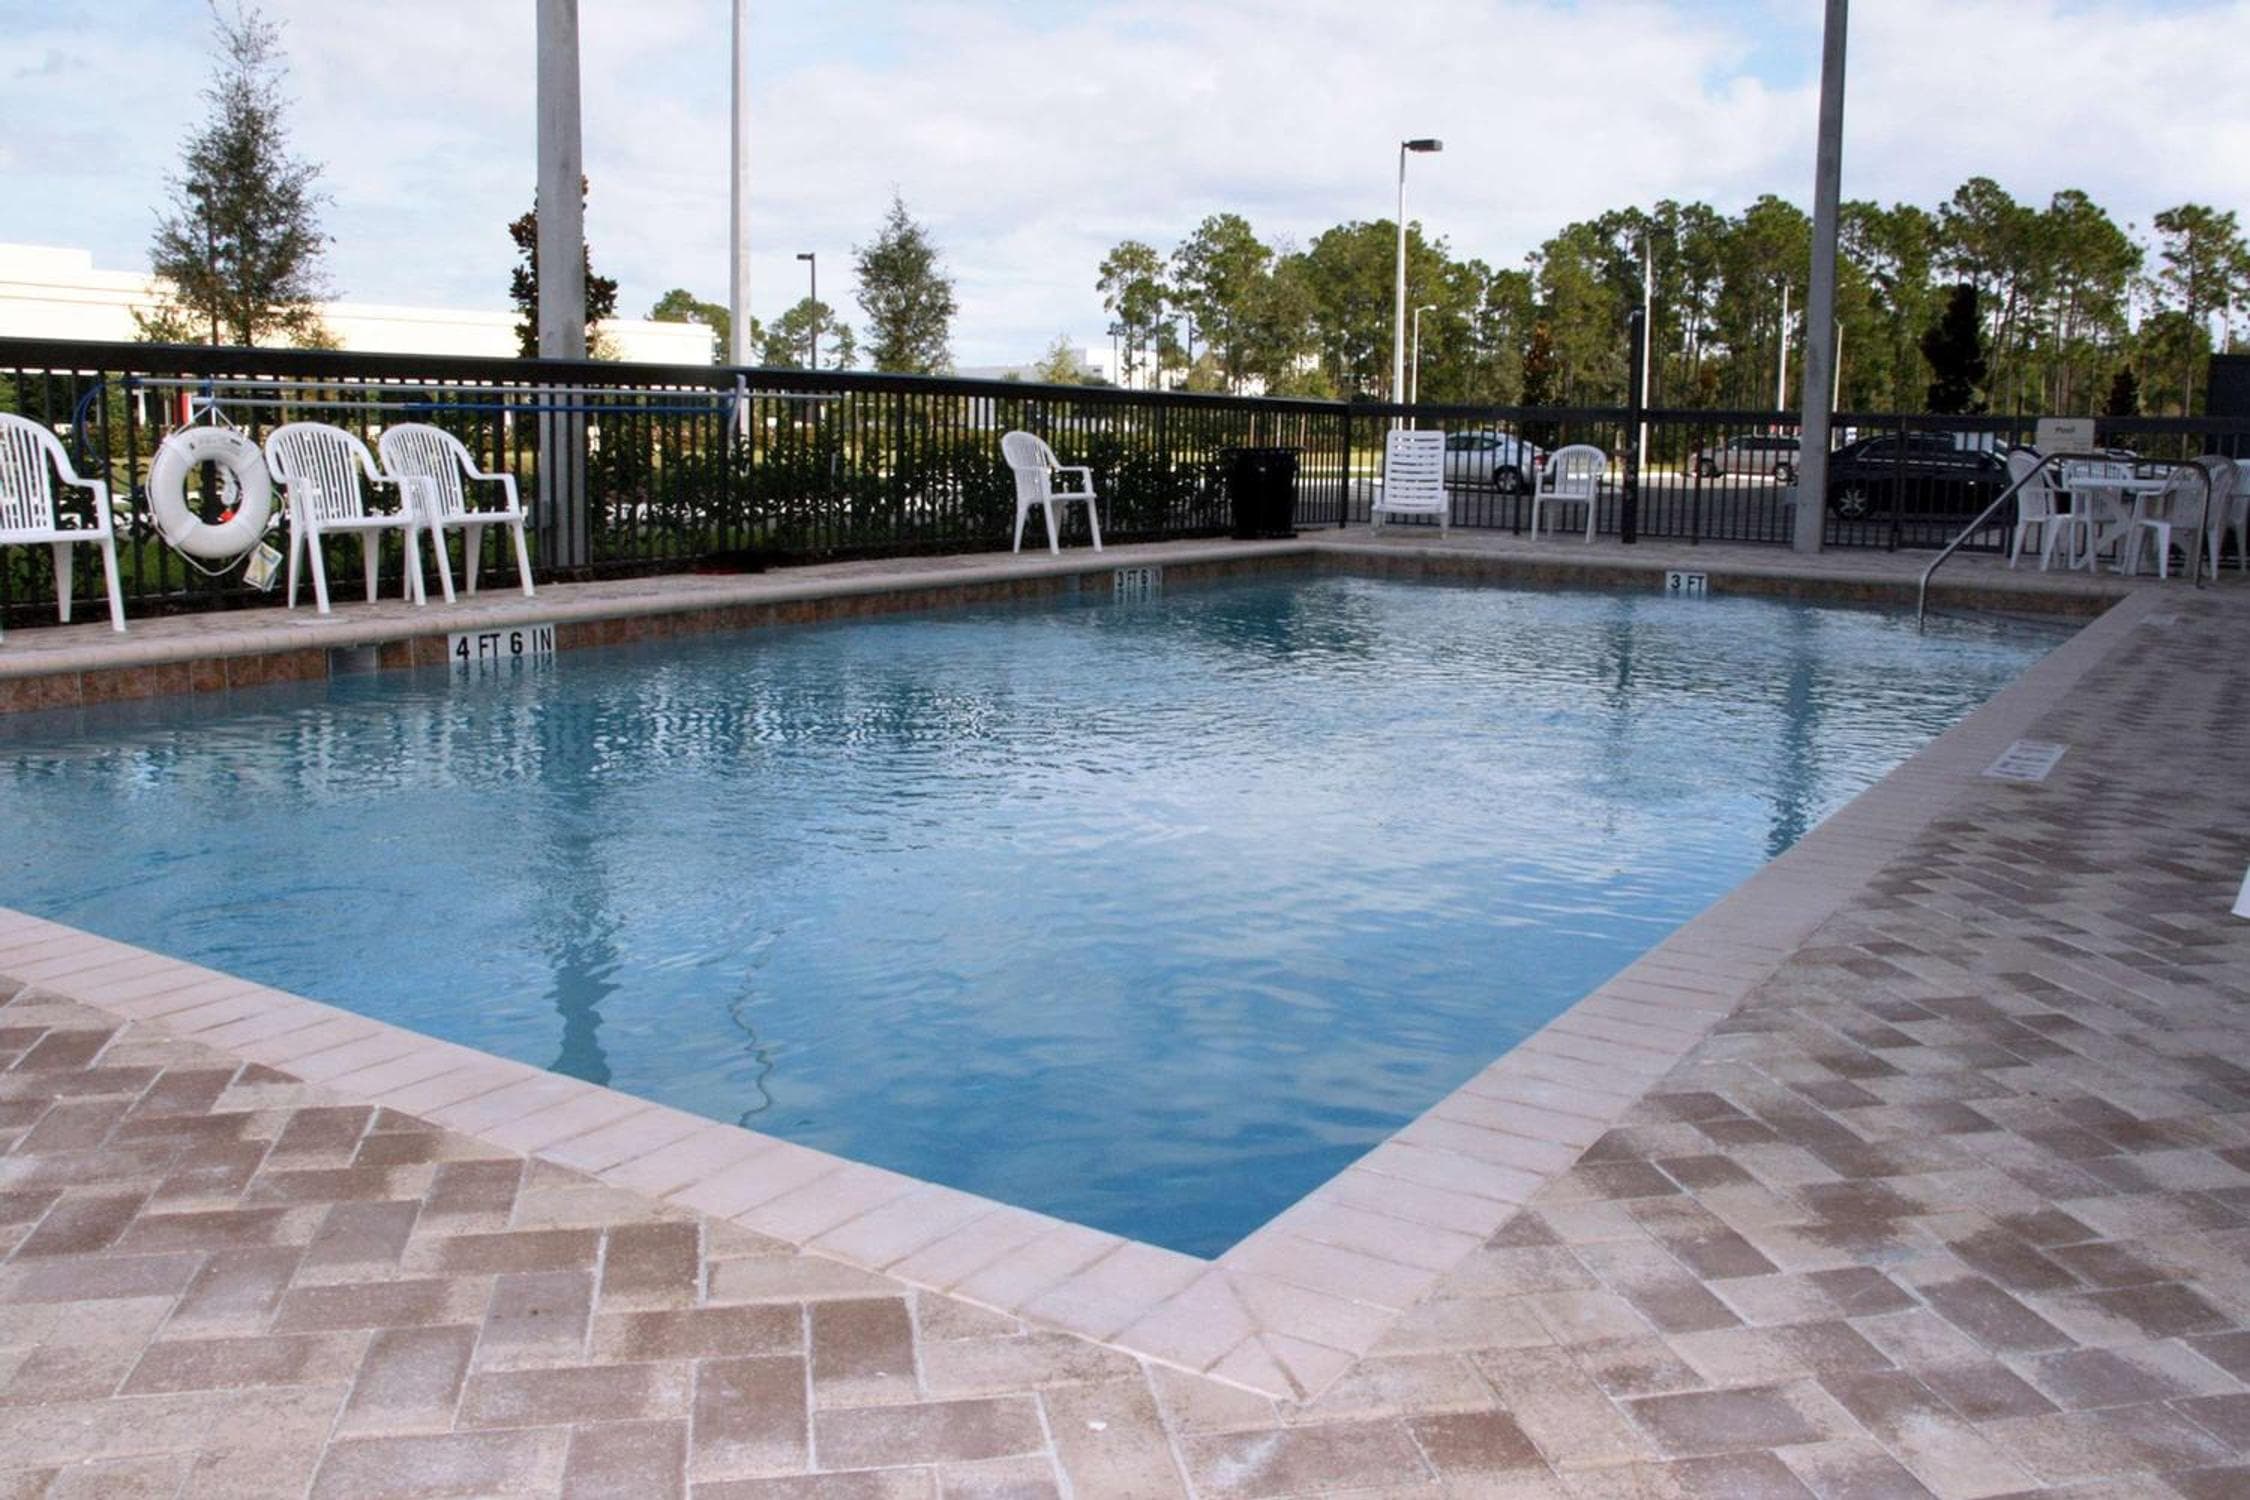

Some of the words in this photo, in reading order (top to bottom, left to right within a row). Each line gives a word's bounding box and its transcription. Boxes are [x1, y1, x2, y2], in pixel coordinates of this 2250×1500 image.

[1671, 574, 1681, 589] 3
[1688, 575, 1705, 591] FT
[455, 635, 471, 661] 4
[478, 633, 501, 658] FT
[510, 631, 524, 655] 6
[532, 627, 552, 652] IN
